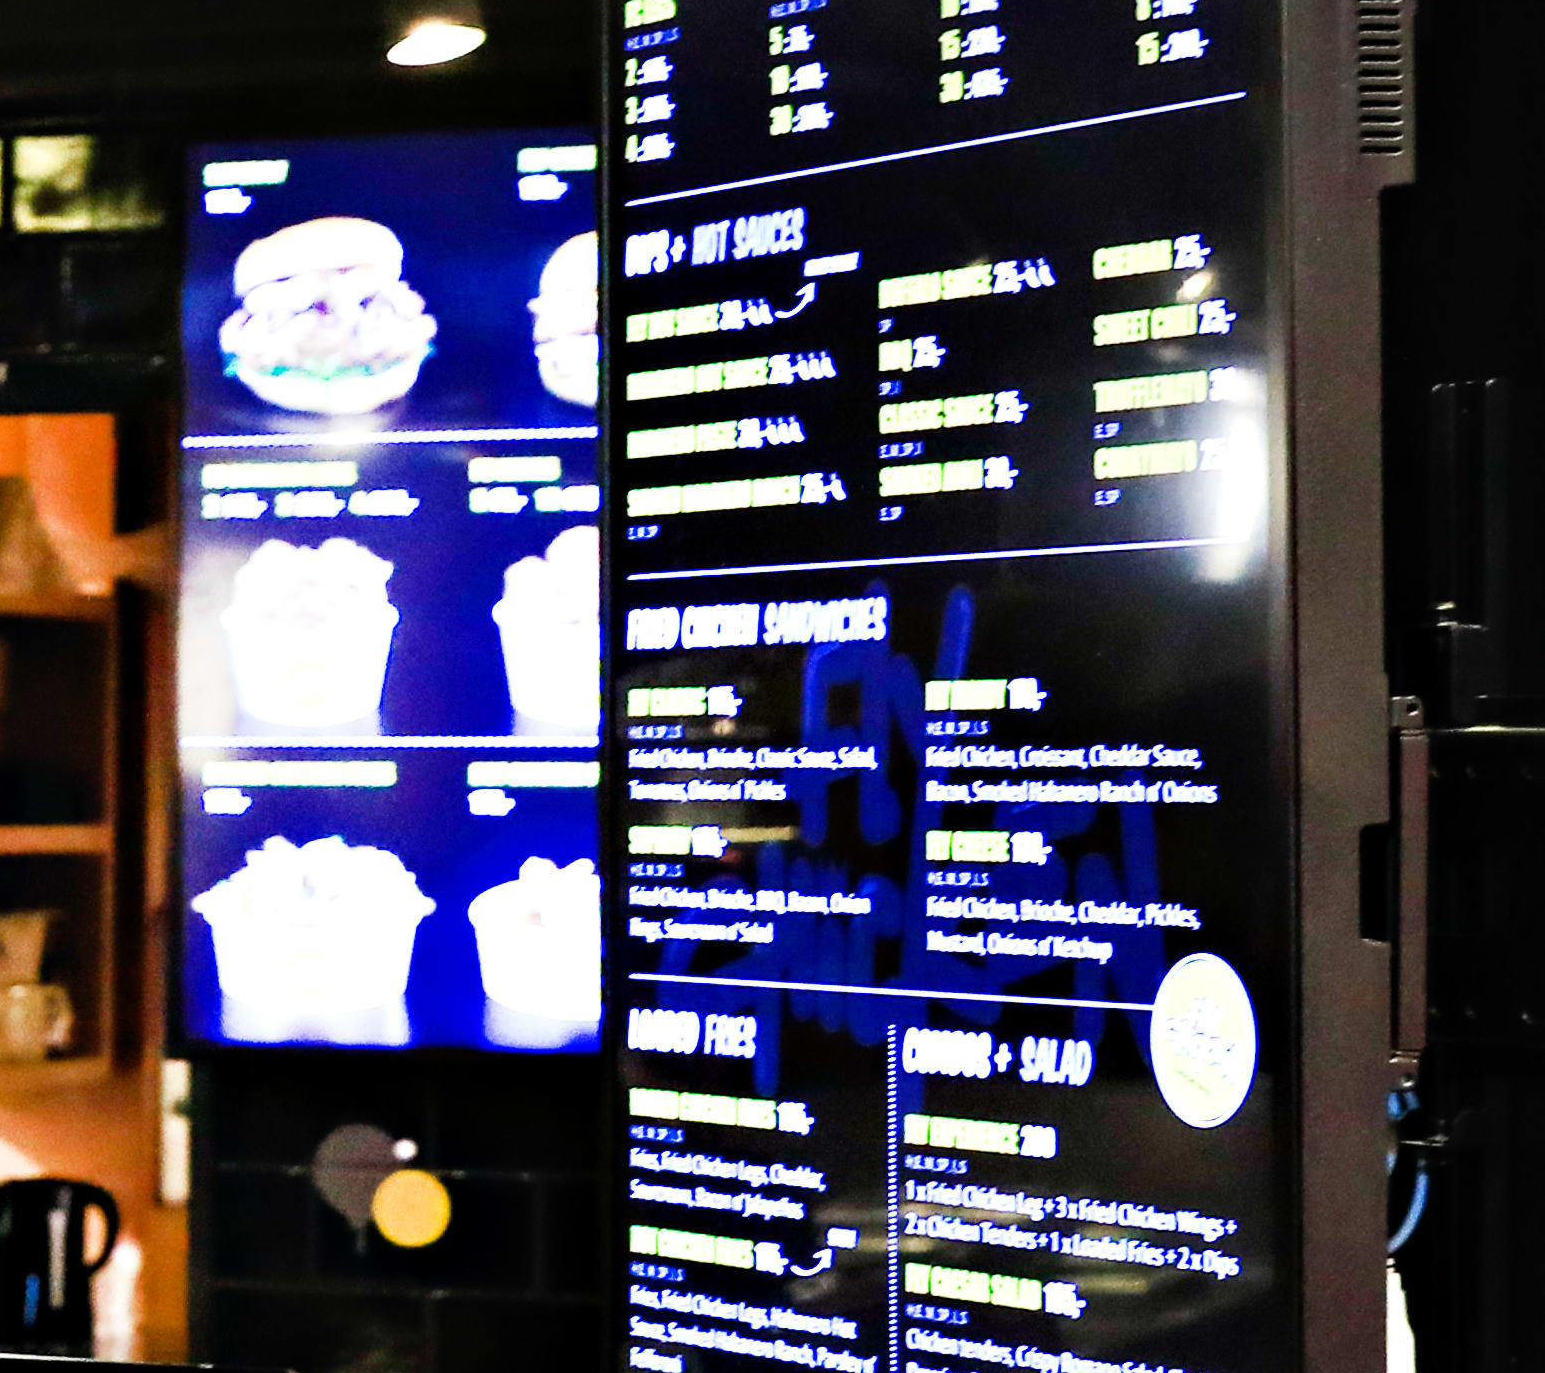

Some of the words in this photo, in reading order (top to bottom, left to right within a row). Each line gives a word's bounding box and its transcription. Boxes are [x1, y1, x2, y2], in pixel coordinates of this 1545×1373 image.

[670, 235, 687, 263] +
[691, 219, 730, 266] HOT
[731, 206, 806, 260] SAUCES
[1093, 309, 1151, 346] SWEET
[626, 606, 680, 650] FRIED
[681, 603, 760, 649] CHICKEN
[762, 596, 888, 645] SANDWICHES
[926, 745, 962, 767] Fried
[962, 745, 1018, 769] Chicken,
[1089, 744, 1149, 768] Cheddar
[1150, 744, 1205, 770] Sauce,
[926, 895, 962, 918] Fried
[963, 897, 1020, 923] Chicken,
[1078, 900, 1145, 928] Cheddar,
[1145, 903, 1202, 930] Pickles,
[1053, 935, 1113, 965] Ketchup
[627, 1008, 700, 1054] LOADED
[703, 1014, 757, 1058] FRIES
[902, 1026, 992, 1079] COMBOS
[993, 1041, 1013, 1073] +
[1018, 1035, 1093, 1087] SALAD
[905, 1179, 917, 1202] 1
[926, 1180, 963, 1207] Fried
[963, 1184, 1017, 1213] Chicken
[1017, 1191, 1045, 1221] Leg
[1055, 1195, 1068, 1218] 3
[1078, 1198, 1117, 1225] Fried
[1117, 1202, 1176, 1231] Chicken
[1176, 1209, 1224, 1243] Wings
[904, 1212, 917, 1235] 2
[926, 1214, 981, 1243] Chicken
[1072, 1232, 1128, 1261] Loaded
[1128, 1240, 1165, 1267] Fries
[1176, 1246, 1190, 1270] 2
[1202, 1249, 1241, 1280] Dips
[991, 1273, 1043, 1311] SALAD
[905, 1328, 959, 1356] Chicken
